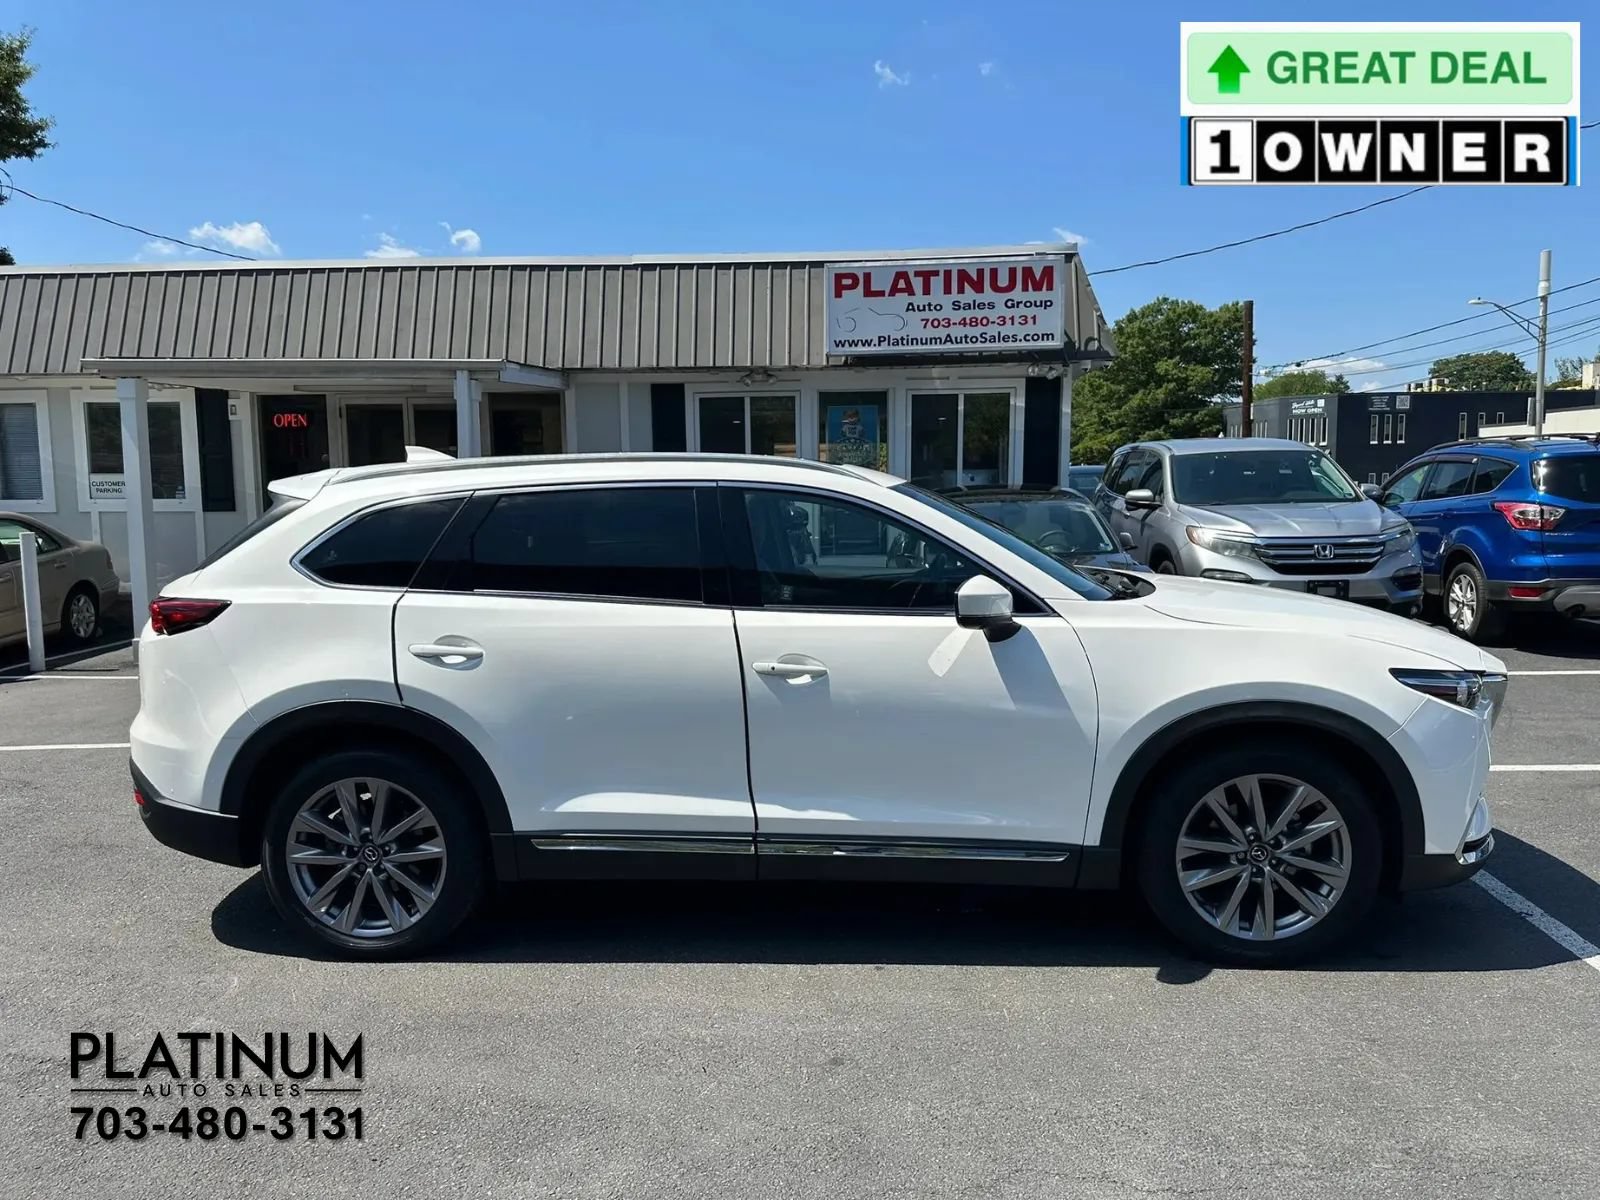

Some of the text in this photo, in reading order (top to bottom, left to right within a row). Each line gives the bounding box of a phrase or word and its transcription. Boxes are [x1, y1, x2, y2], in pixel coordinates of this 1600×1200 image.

[834, 265, 1055, 298] PLATINUM
[905, 298, 1054, 313] Auto Sales Group
[921, 315, 1037, 329] 703-480-3131
[834, 331, 1055, 349] www.PlatinumAutoSales.com
[273, 413, 308, 428] OPEN
[91, 480, 126, 488] CUSTOMER
